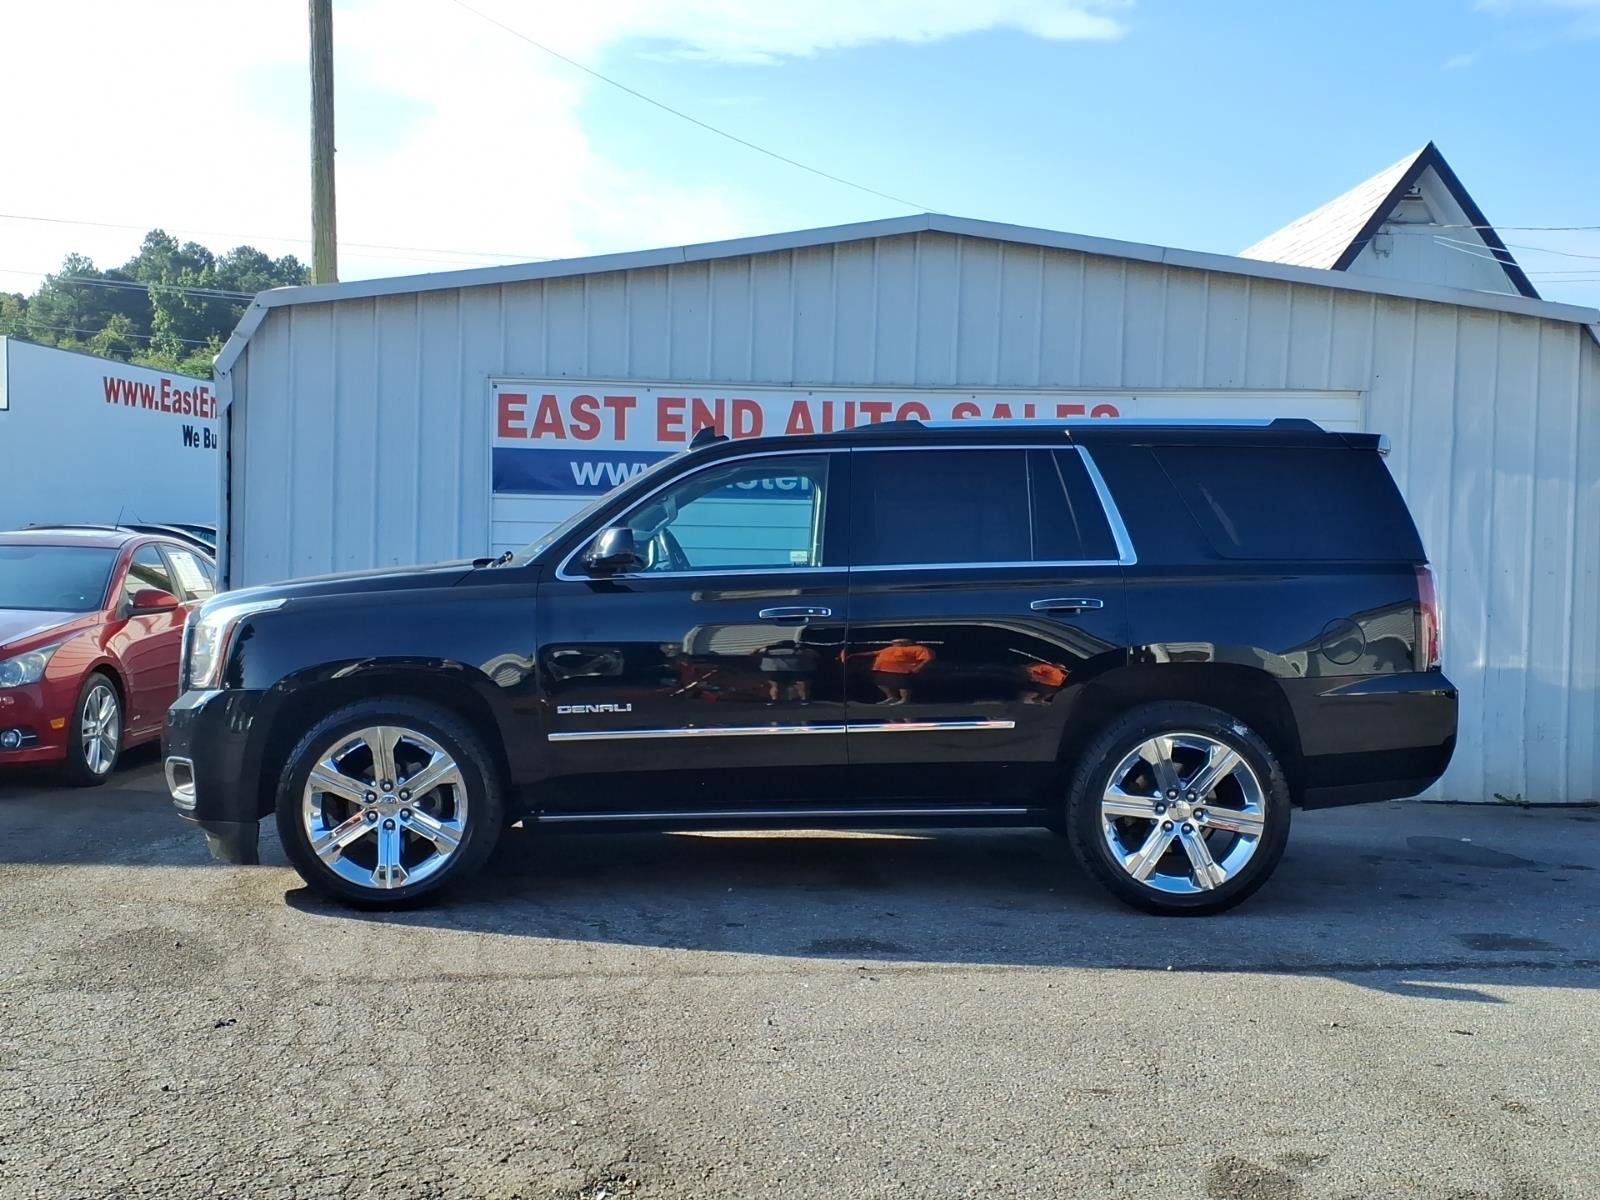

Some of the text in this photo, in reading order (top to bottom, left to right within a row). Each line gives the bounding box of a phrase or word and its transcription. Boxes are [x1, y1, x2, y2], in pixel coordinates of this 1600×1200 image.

[497, 393, 637, 441] EAST
[657, 397, 764, 442] END
[182, 424, 200, 448] We
[570, 461, 648, 486] ww
[557, 703, 632, 714] DENALI
